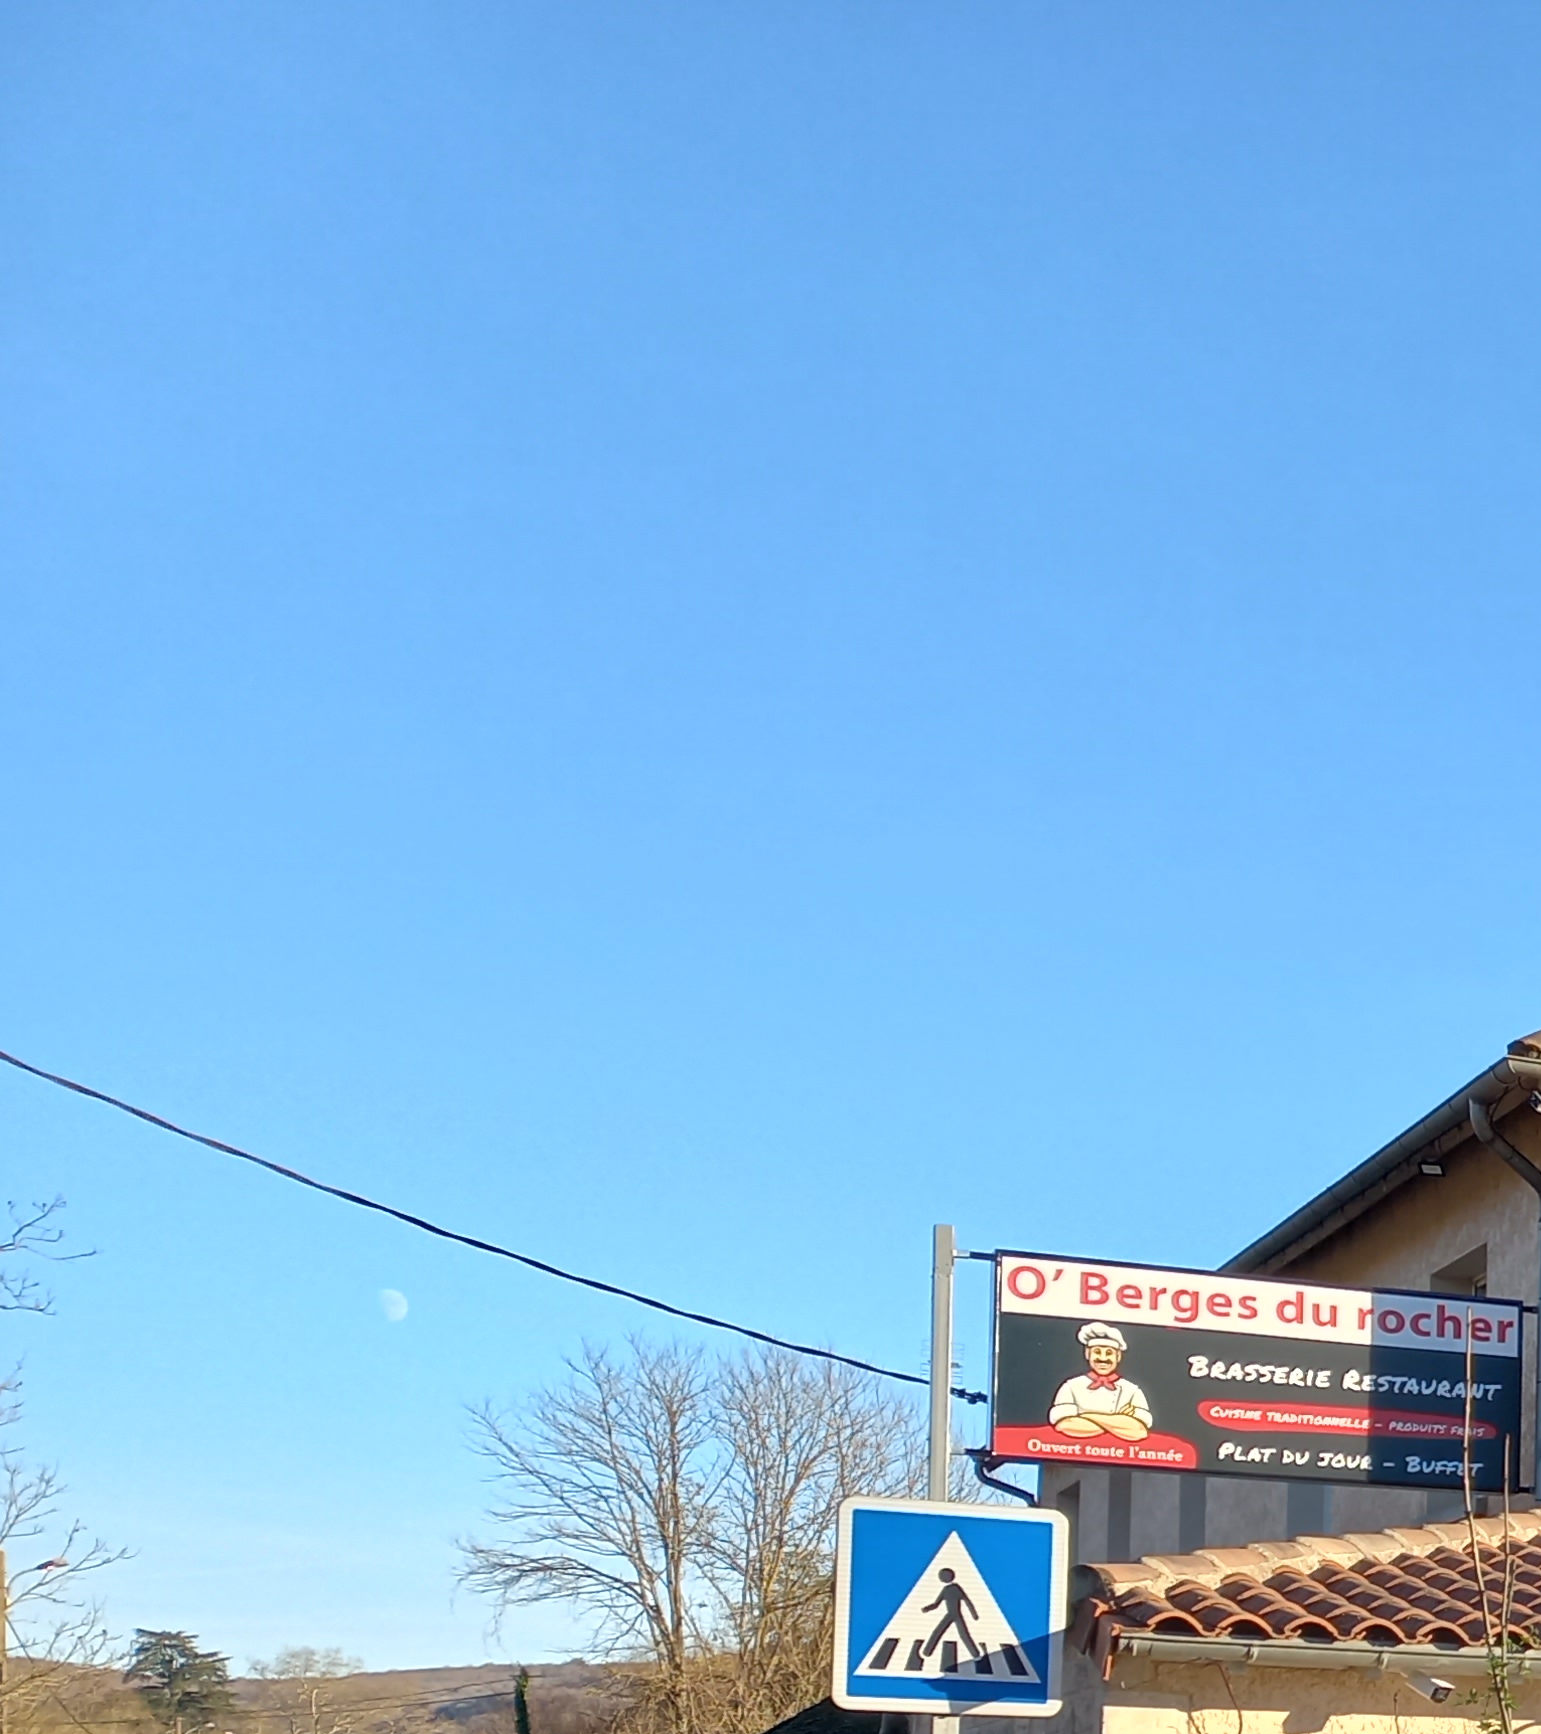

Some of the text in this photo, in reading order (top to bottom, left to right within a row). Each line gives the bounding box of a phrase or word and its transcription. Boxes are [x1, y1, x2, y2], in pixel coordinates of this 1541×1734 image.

[1079, 1271, 1258, 1323] Berges
[1276, 1290, 1337, 1327] du
[1357, 1304, 1514, 1343] rocher
[1187, 1355, 1502, 1401] BRASSERIE RESTAURANT
[1210, 1406, 1262, 1422] CUISINE
[1388, 1420, 1447, 1434] PRODUITS
[1027, 1439, 1183, 1462] Ouvert toute l'année
[1218, 1442, 1277, 1463] PLAT
[1282, 1449, 1310, 1465] DU
[1317, 1452, 1373, 1470] JOUR
